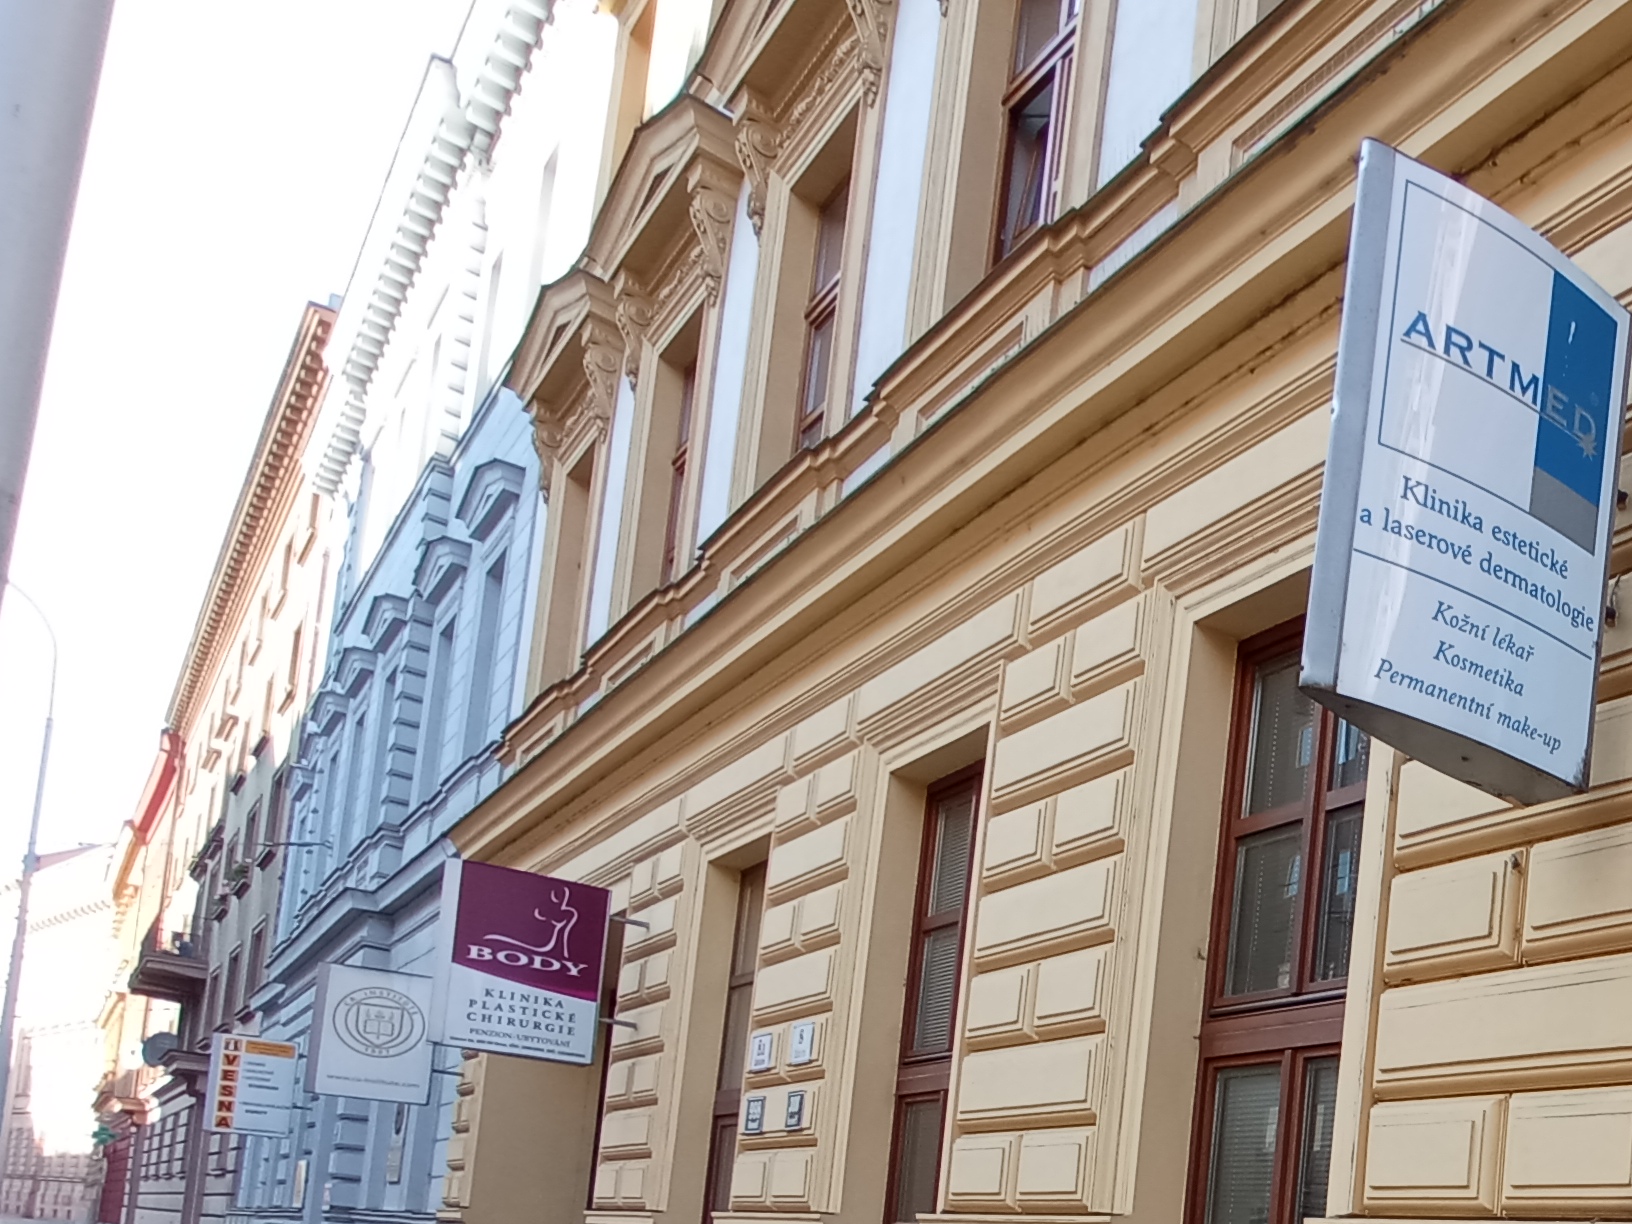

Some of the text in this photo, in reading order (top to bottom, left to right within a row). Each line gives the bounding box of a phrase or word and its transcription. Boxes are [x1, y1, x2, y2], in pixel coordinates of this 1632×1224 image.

[1402, 310, 1597, 444] ARTMED
[1400, 475, 1569, 580] Klinika estetické
[1359, 507, 1595, 633] a laserové dermatologie
[1431, 600, 1536, 663] Kožní lékař
[1433, 640, 1525, 697] Kosmetika
[1373, 658, 1562, 755] Permanentní make-up
[466, 944, 589, 977] BODY
[466, 1011, 576, 1037] CHIRURGIE
[468, 998, 577, 1024] PLASTICKÉ
[484, 988, 565, 1009] KLINIKA
[469, 1027, 513, 1040] PENZION
[215, 1053, 241, 1129] VESNA
